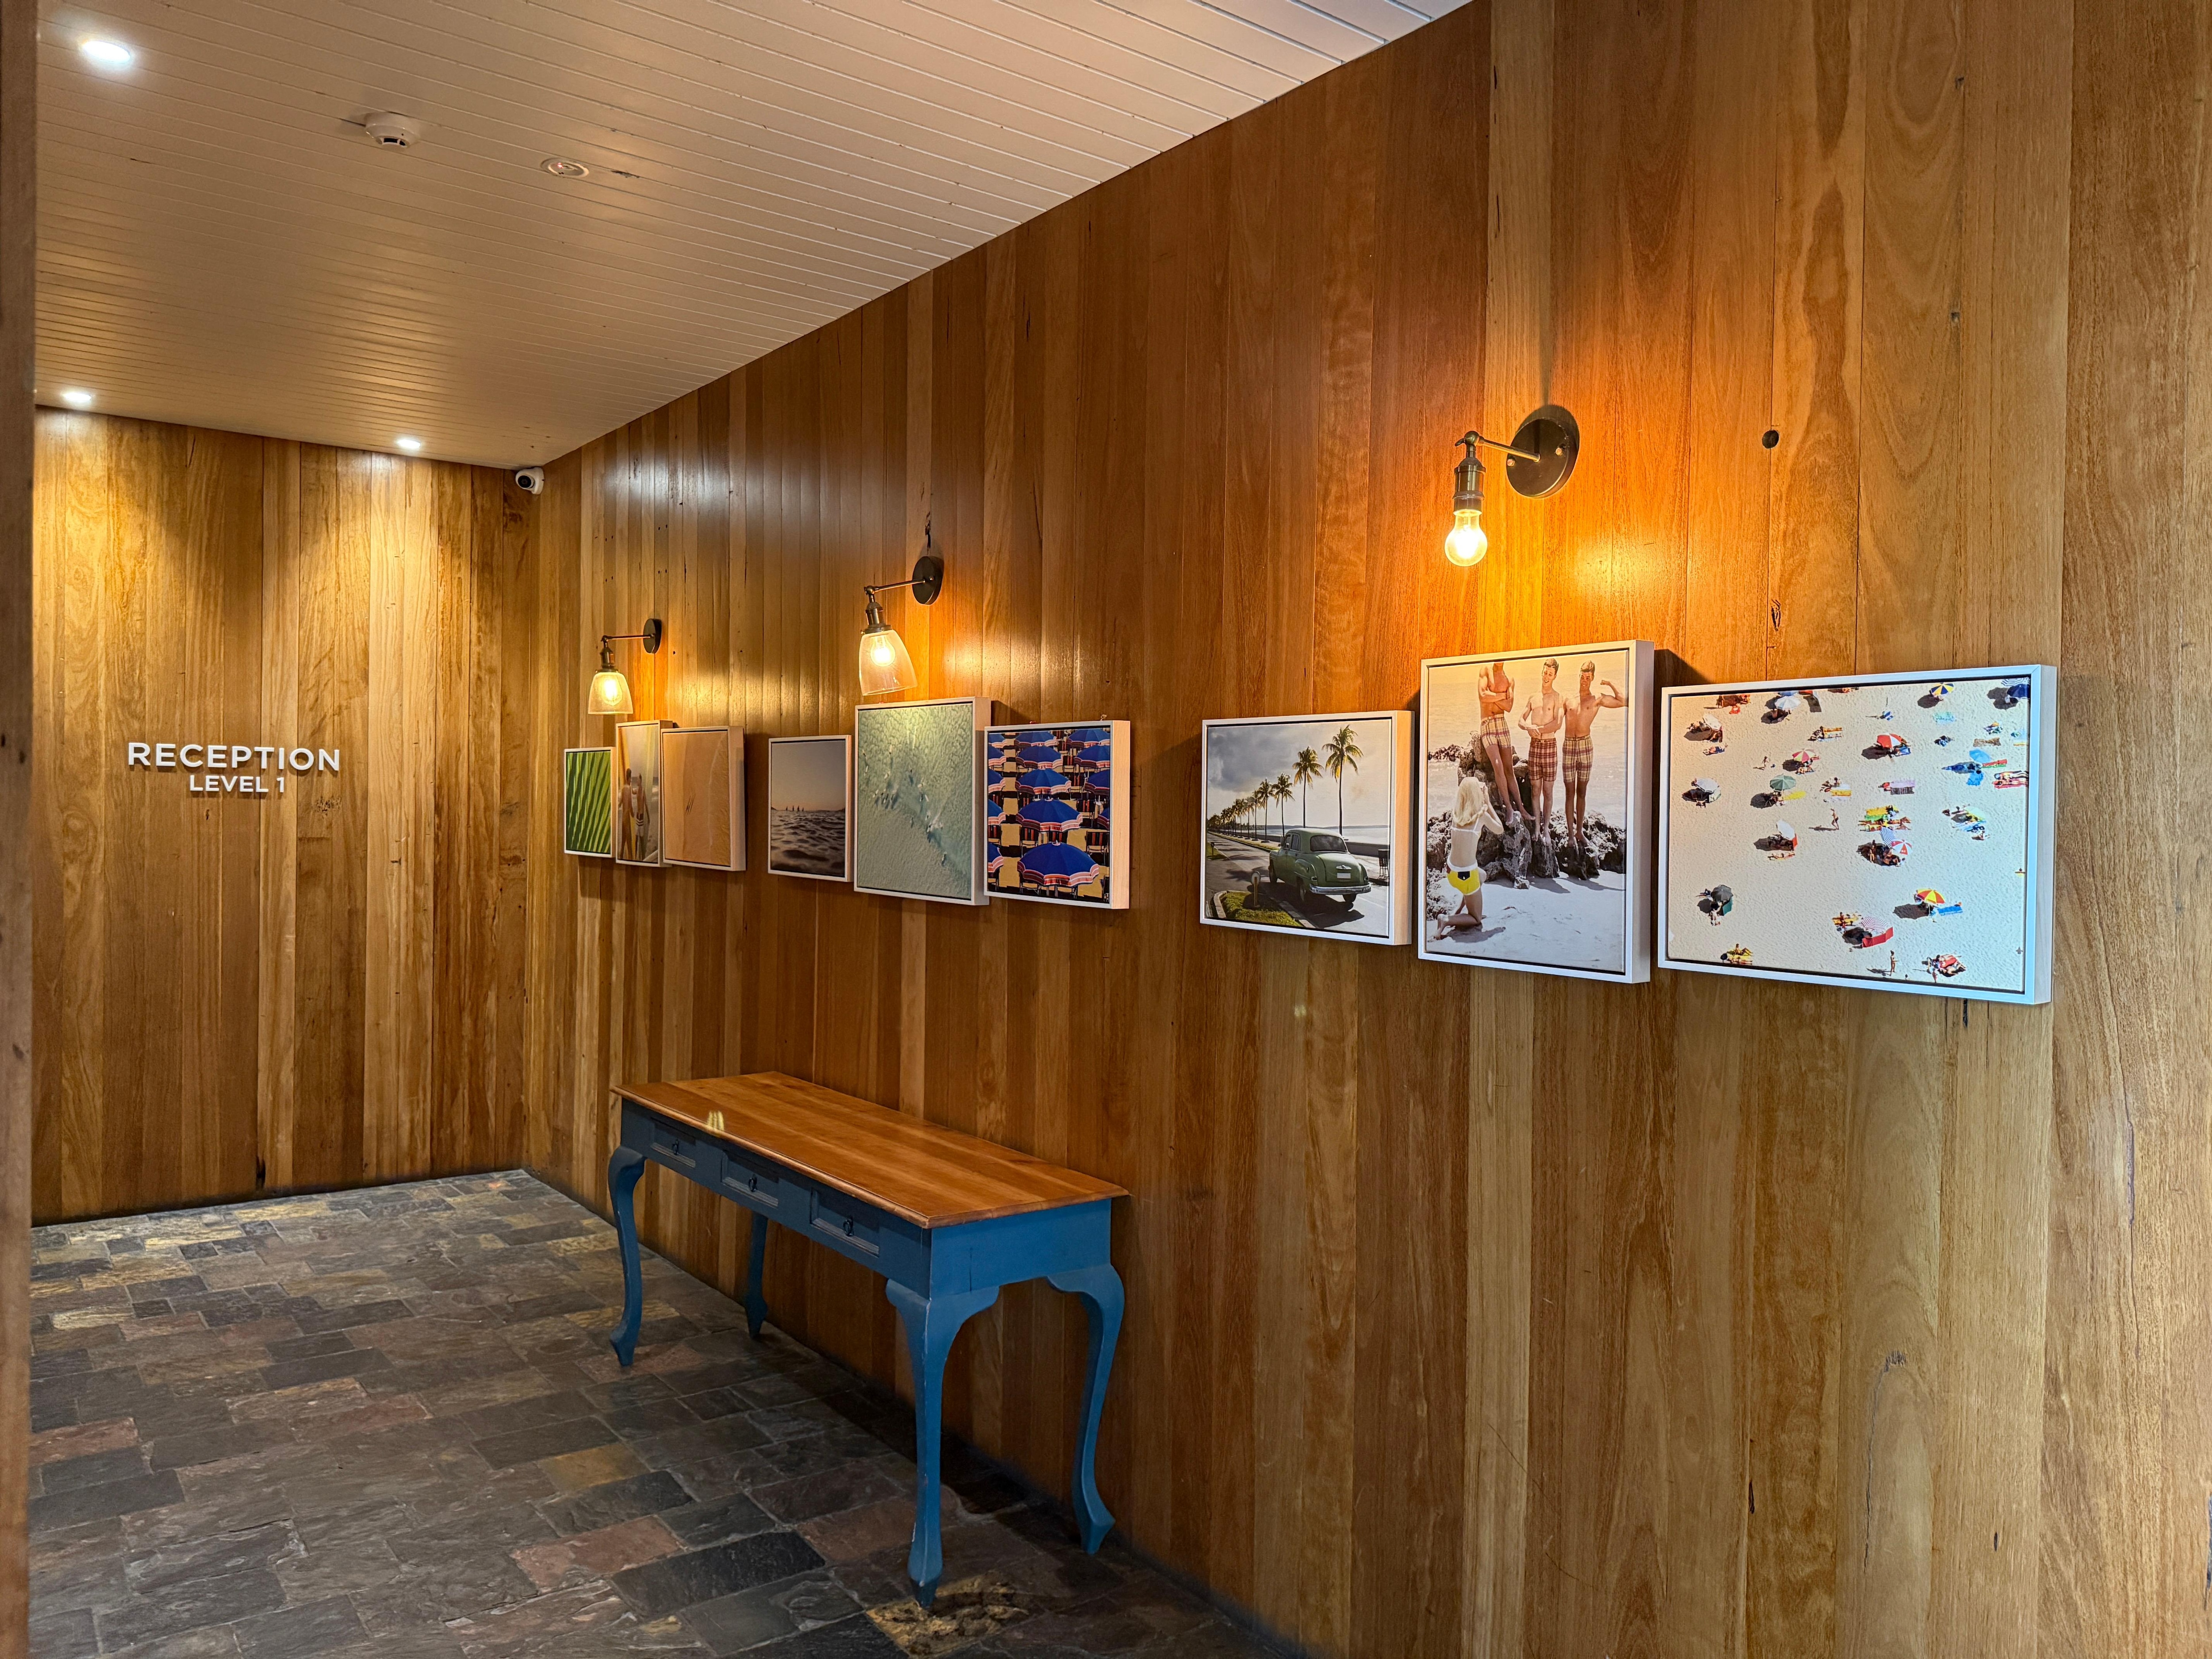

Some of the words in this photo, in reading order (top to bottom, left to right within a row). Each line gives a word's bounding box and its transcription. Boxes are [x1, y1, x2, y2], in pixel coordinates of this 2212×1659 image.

[128, 742, 340, 771] RECEPTION
[189, 775, 269, 793] LEVEL
[276, 777, 284, 793] 1
